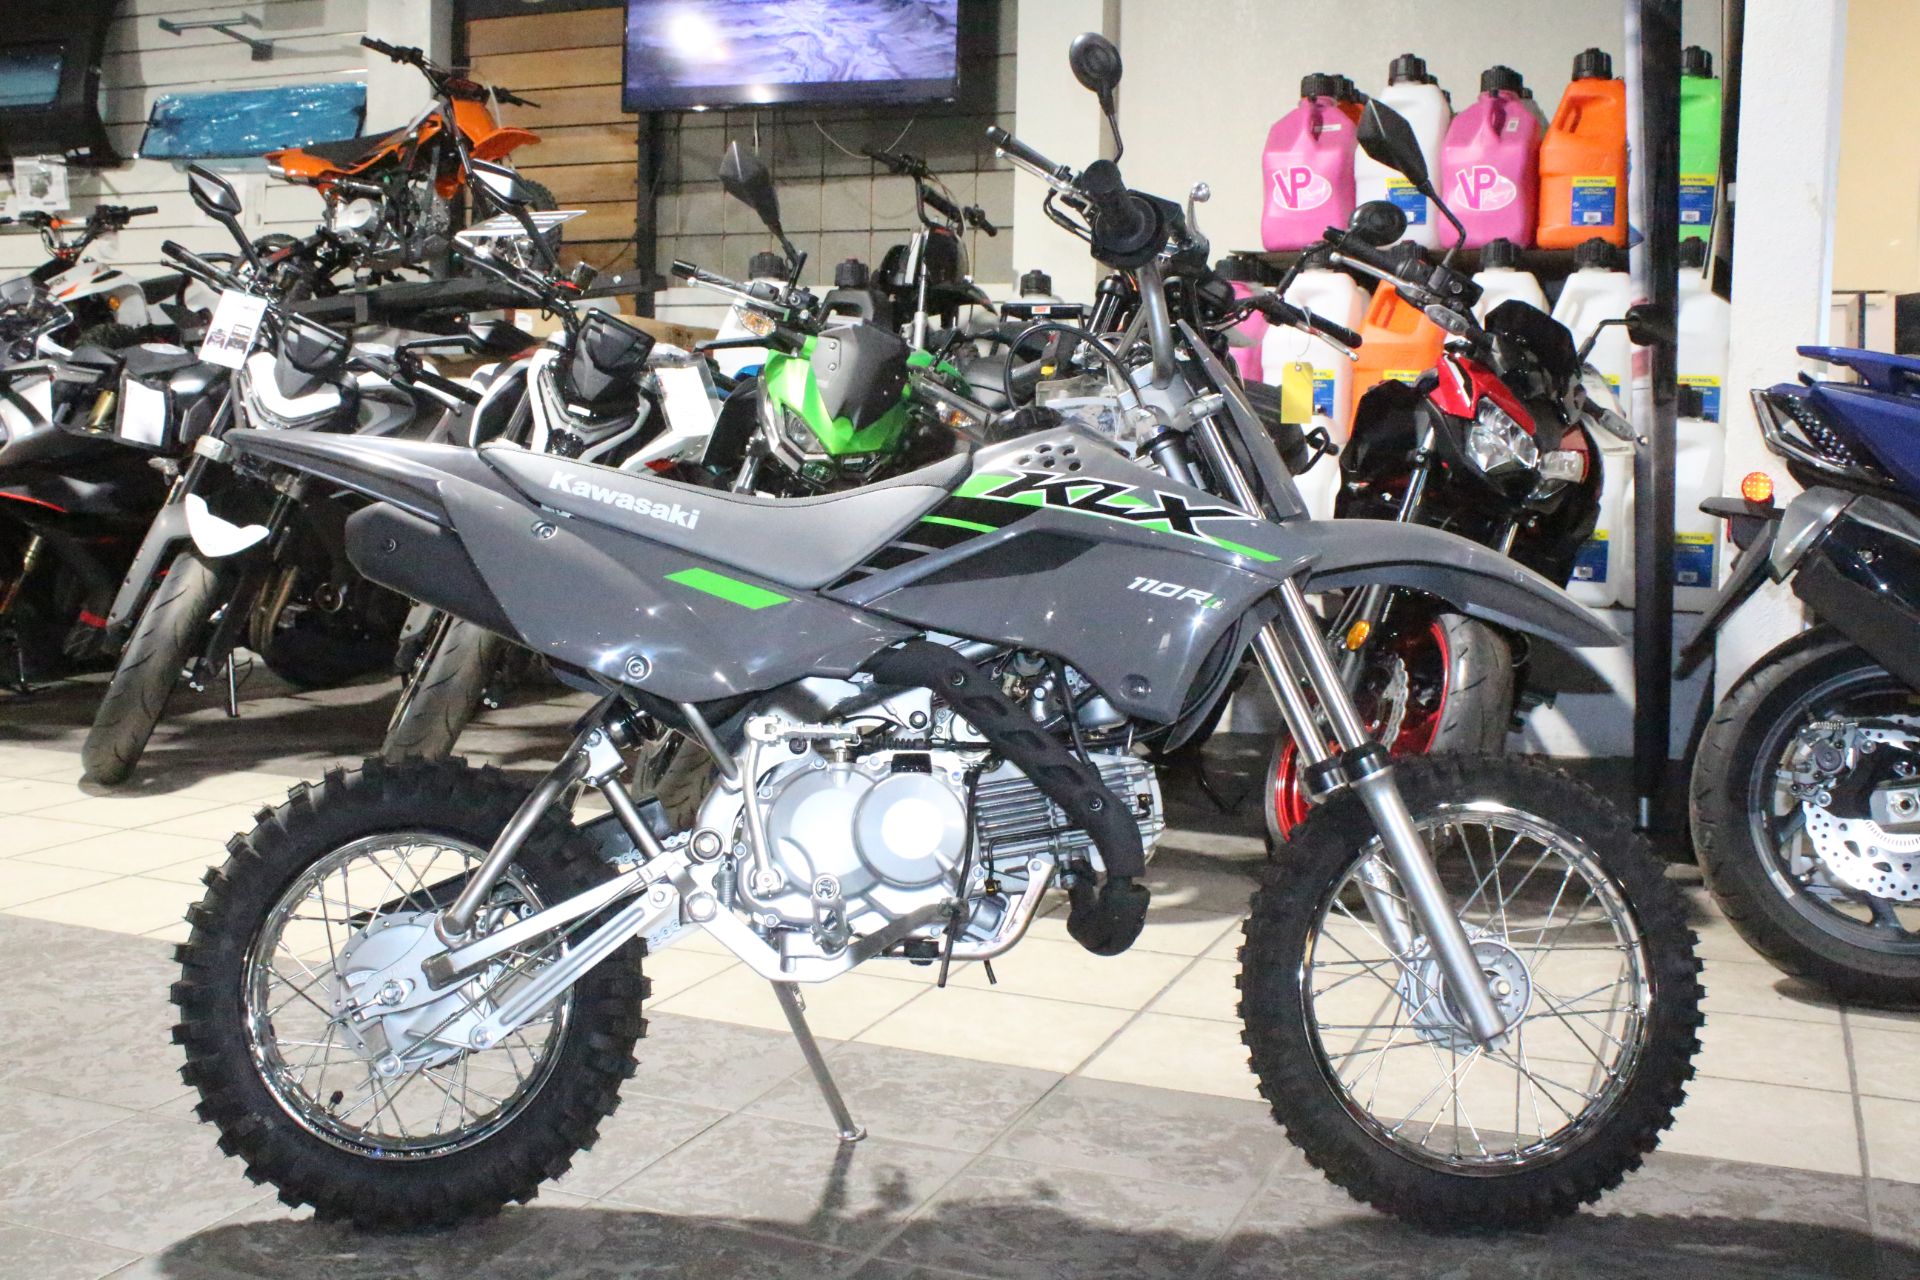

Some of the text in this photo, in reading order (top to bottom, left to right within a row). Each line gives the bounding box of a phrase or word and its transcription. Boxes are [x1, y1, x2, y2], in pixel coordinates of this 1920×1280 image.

[1272, 165, 1312, 209] VP
[1456, 165, 1498, 209] VP
[549, 471, 700, 529] Kawasaki
[980, 469, 1260, 546] KLX
